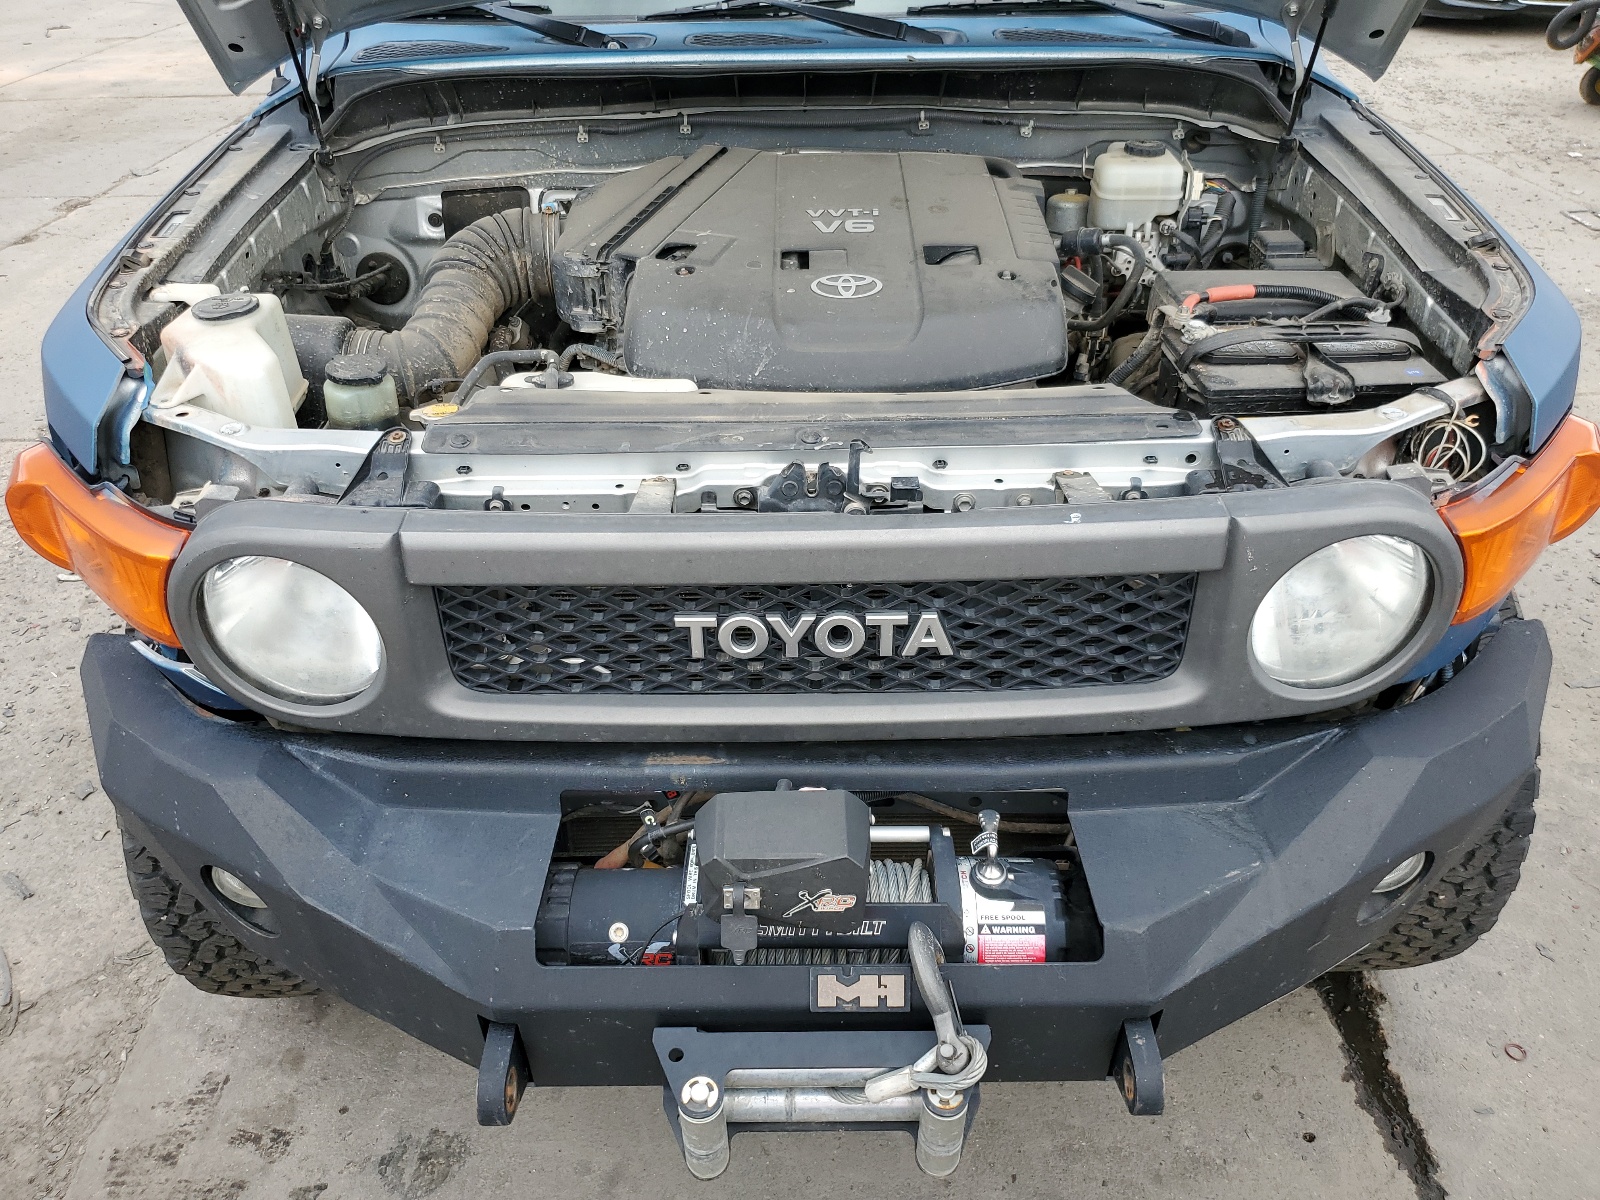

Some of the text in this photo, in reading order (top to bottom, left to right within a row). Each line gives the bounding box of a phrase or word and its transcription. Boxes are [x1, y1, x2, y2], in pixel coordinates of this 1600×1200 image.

[805, 208, 879, 218] VVT-i
[811, 219, 875, 234] V6
[673, 611, 954, 659] TOYOTA
[991, 925, 1036, 934] WARNING
